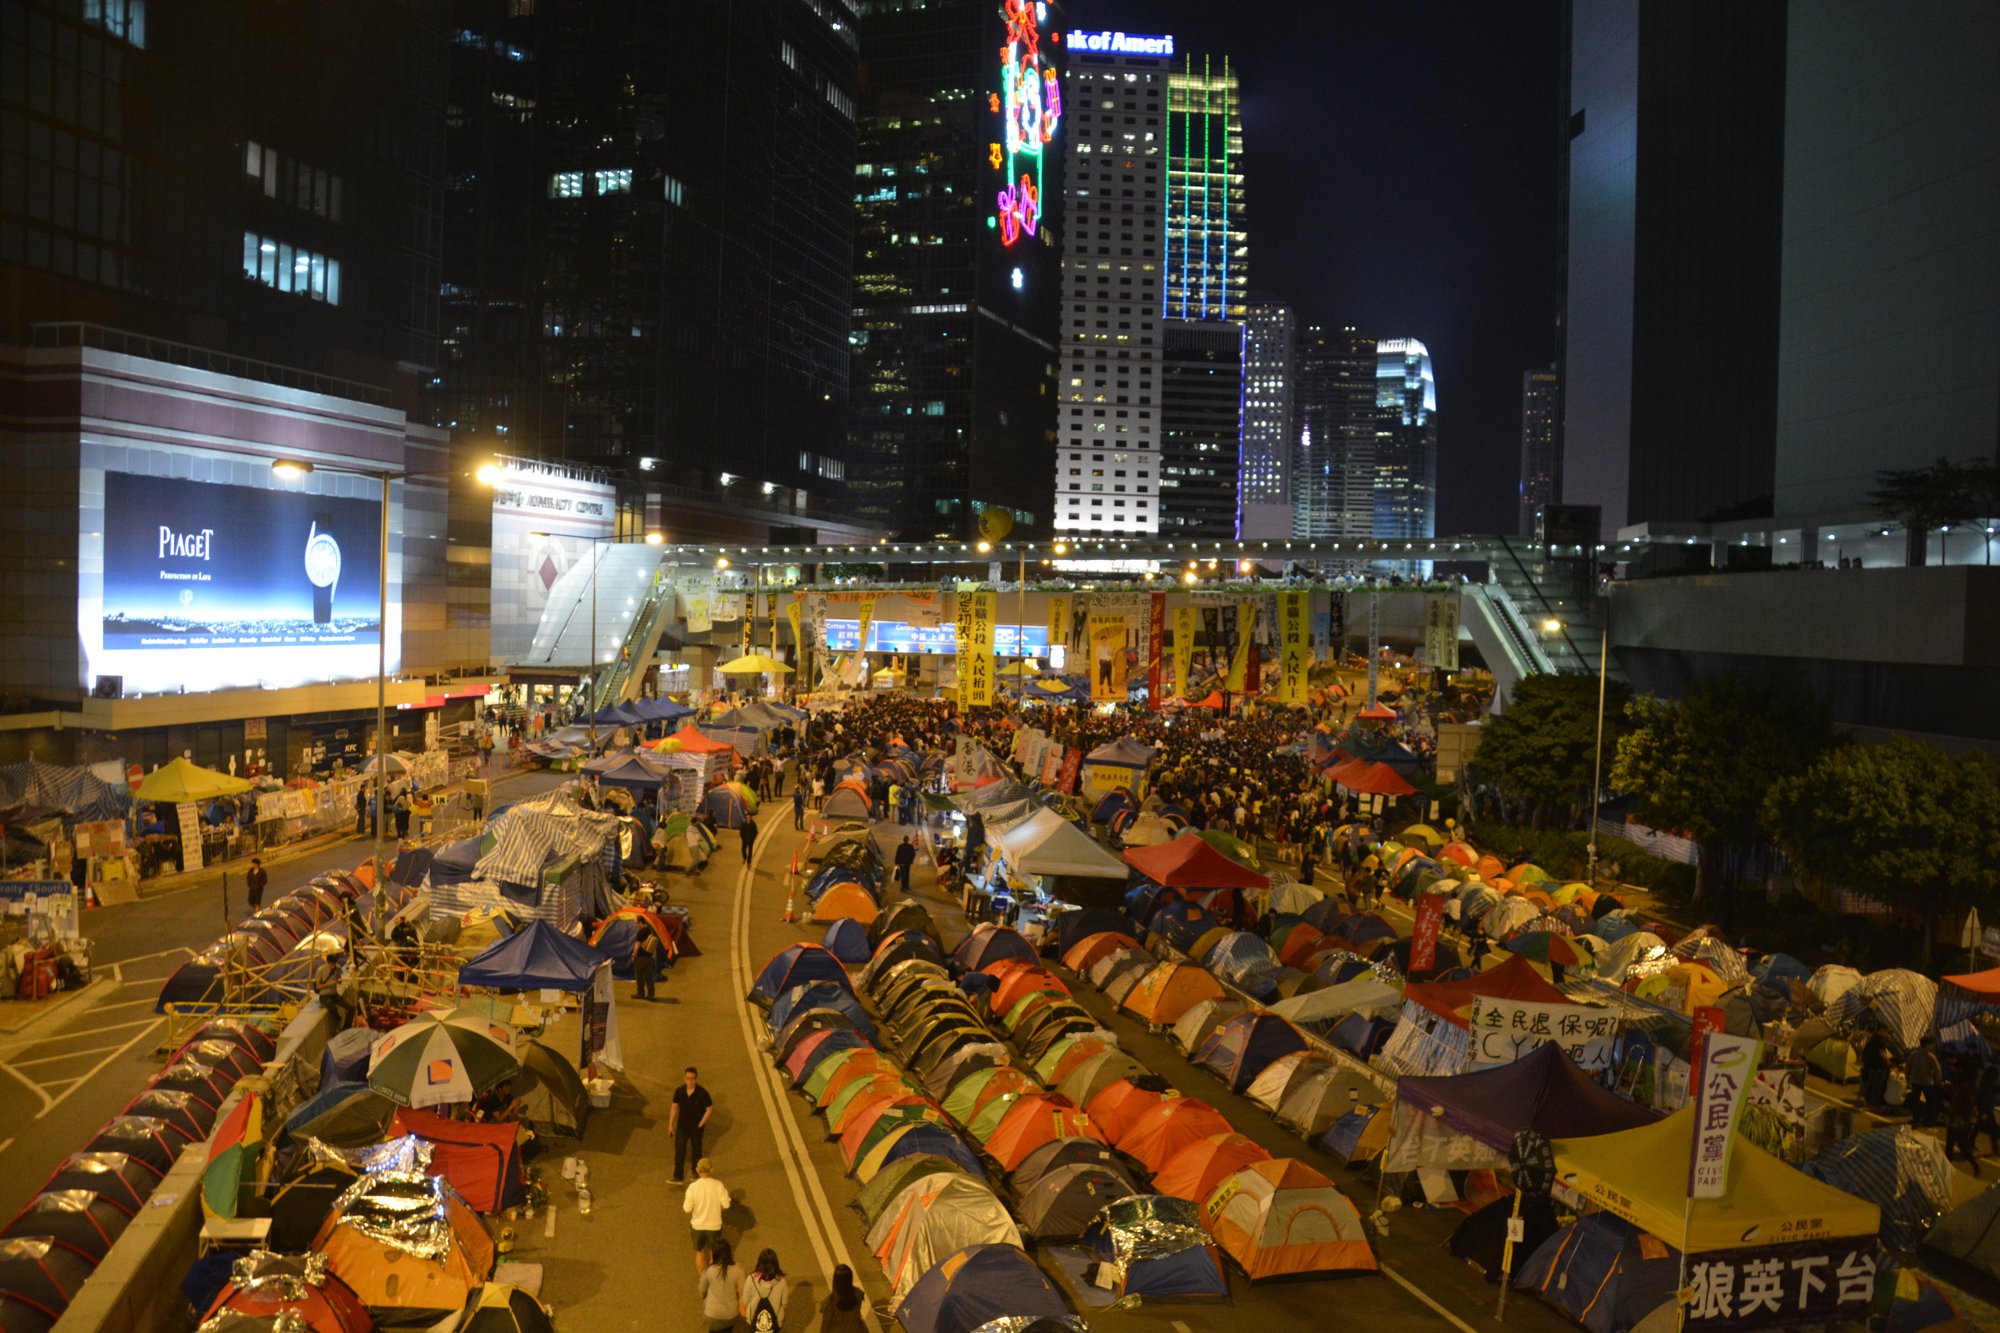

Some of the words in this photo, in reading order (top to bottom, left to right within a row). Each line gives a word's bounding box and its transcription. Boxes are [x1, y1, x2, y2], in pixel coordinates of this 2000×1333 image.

[1088, 31, 1111, 50] of
[1110, 32, 1174, 54] Ameri
[159, 525, 214, 561] PIAGET
[344, 744, 358, 753] KFC
[1702, 1072, 1738, 1162] 公民黨
[1594, 1183, 1633, 1211] 公民黨
[1781, 1217, 1823, 1233] 公民黨
[1689, 1250, 1877, 1320] 狼英下台
